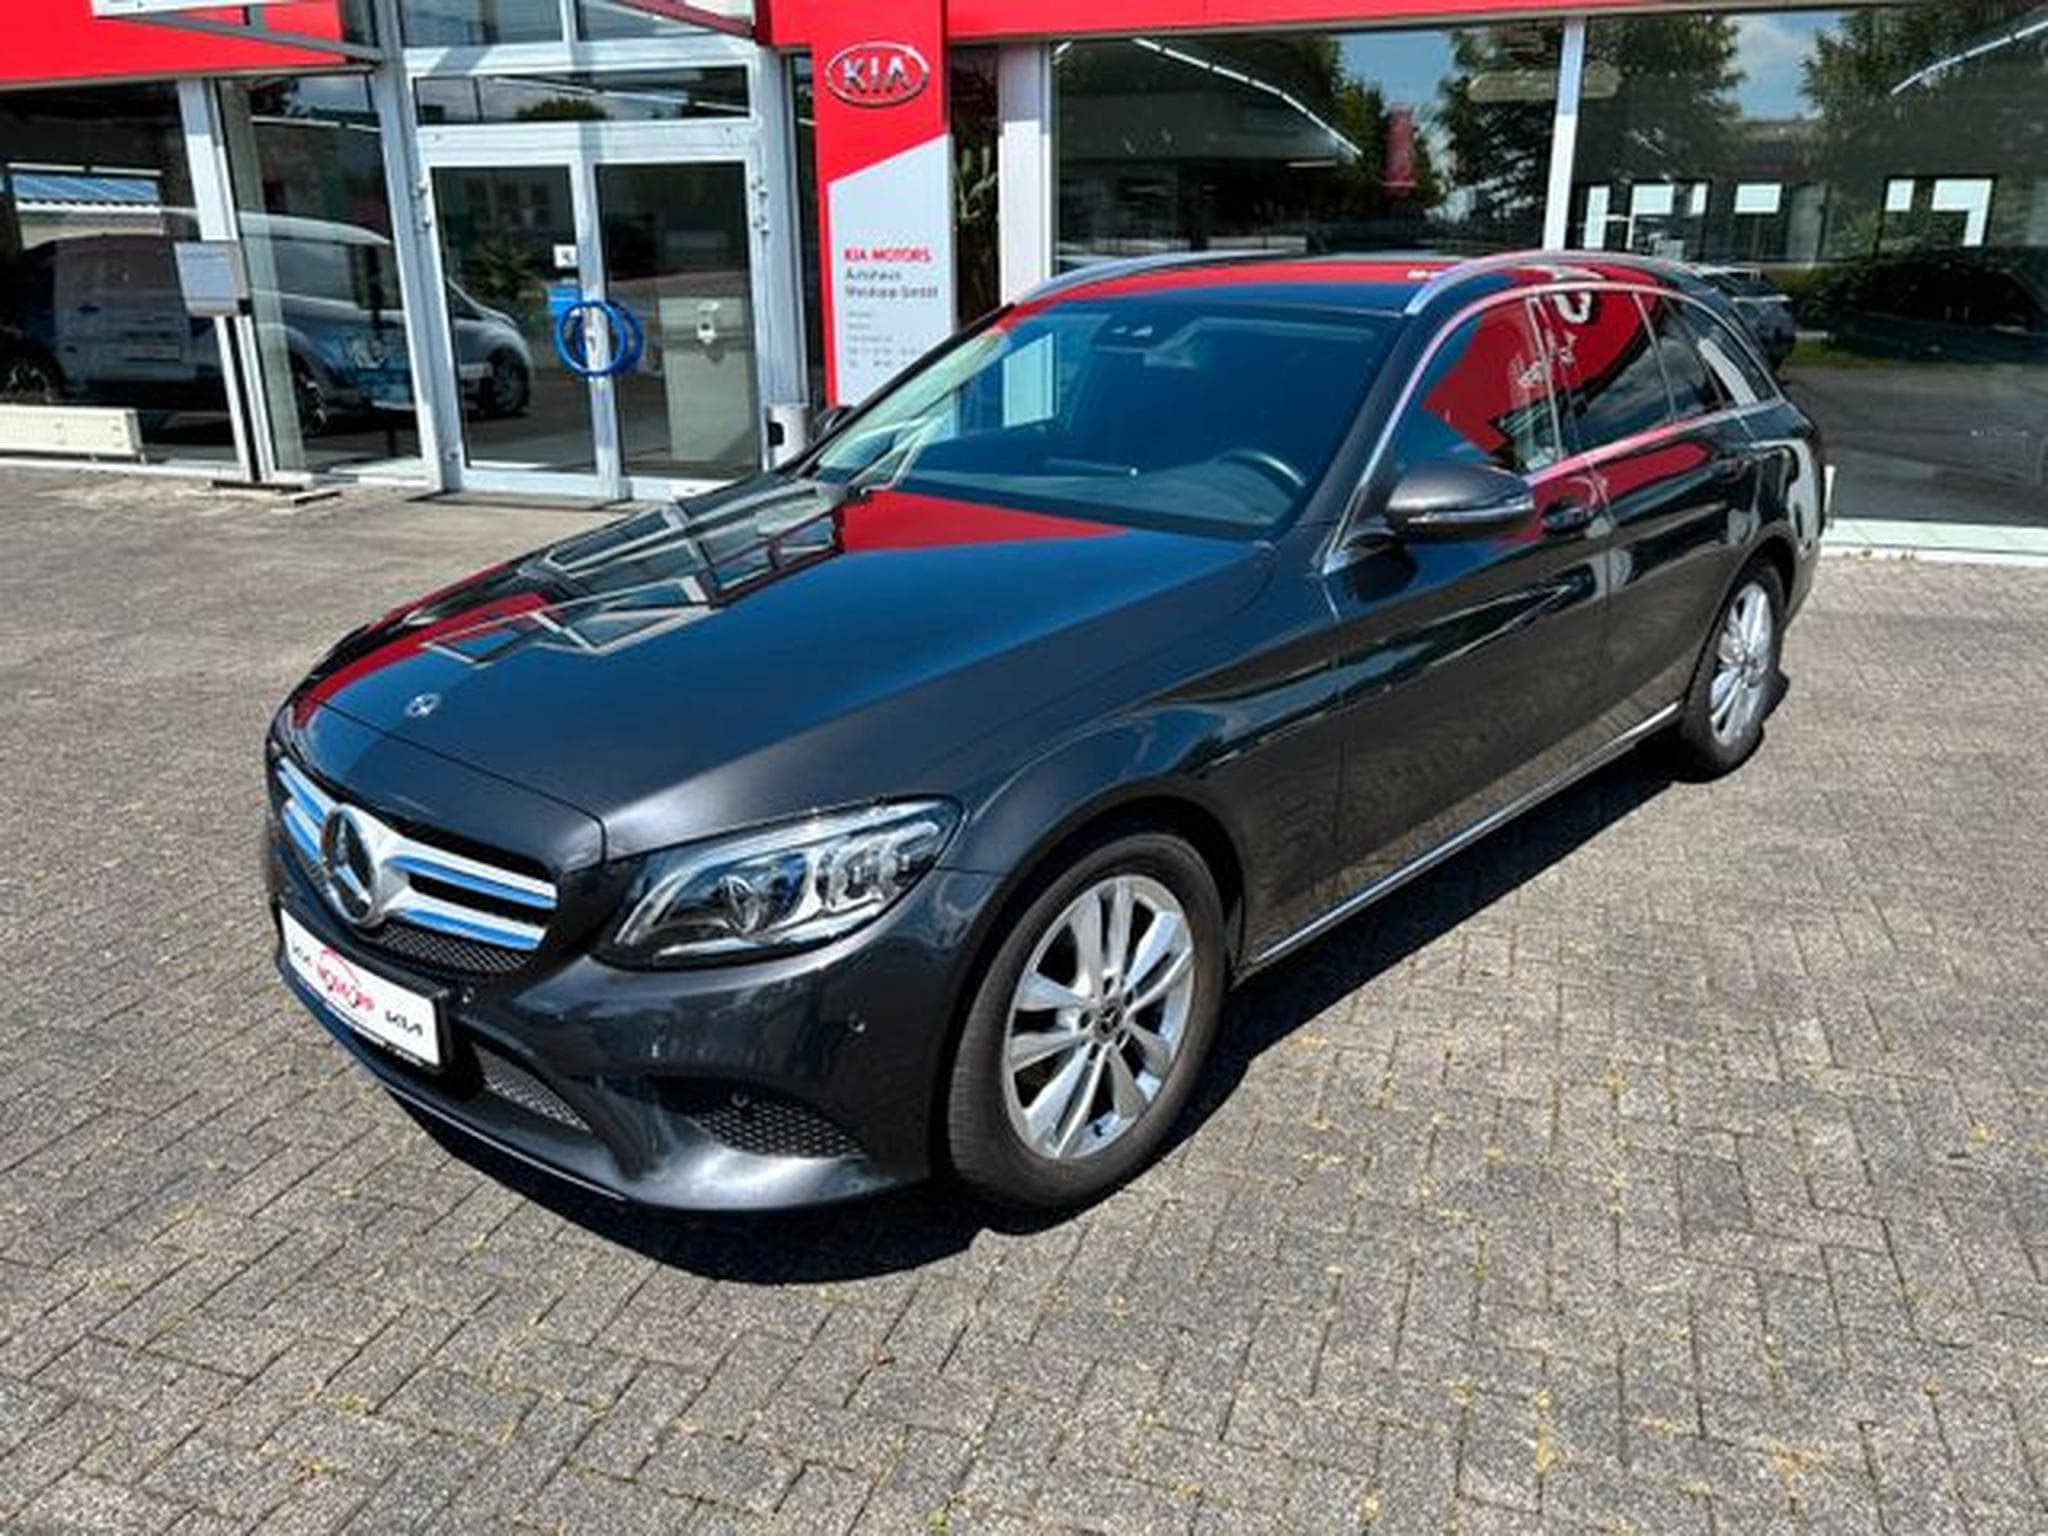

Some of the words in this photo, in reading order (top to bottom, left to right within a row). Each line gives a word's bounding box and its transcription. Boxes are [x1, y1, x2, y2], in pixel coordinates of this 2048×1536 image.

[842, 56, 910, 91] KIA
[844, 247, 866, 262] KIA
[872, 247, 932, 263] MOTORS
